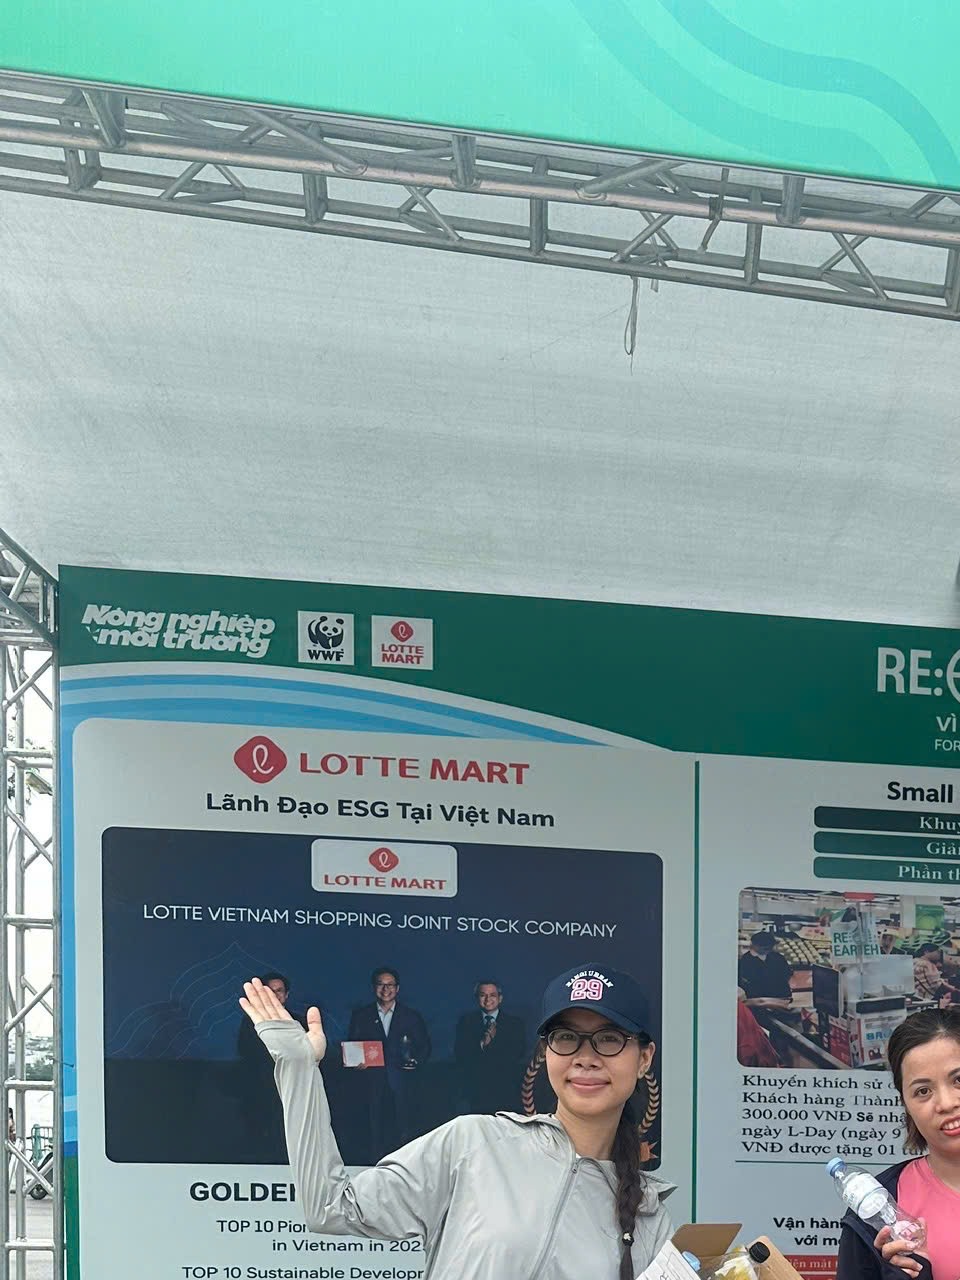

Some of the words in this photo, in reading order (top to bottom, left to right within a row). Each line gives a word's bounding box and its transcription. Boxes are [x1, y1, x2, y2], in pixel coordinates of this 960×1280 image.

[308, 649, 344, 661] WWF
[381, 643, 423, 654] LOTTE
[382, 653, 423, 664] MART
[876, 646, 943, 696] RE:
[936, 714, 958, 733] VÌ
[300, 753, 419, 778] LOTTE
[430, 759, 529, 785] MART
[887, 780, 953, 804] Small
[206, 793, 268, 813] Lãnh
[277, 797, 328, 819] Đạo
[338, 798, 388, 819] ESG
[396, 800, 432, 821] Tại
[440, 802, 489, 827] Việt
[497, 808, 554, 827] Nam
[898, 865, 942, 881] Phần
[324, 875, 386, 888] LOTTE
[391, 877, 446, 890] MART
[143, 905, 202, 921] LOTTE
[208, 907, 289, 924] VIETNAM
[295, 910, 392, 928] SHOPPING
[397, 914, 450, 931] JOINT
[457, 917, 519, 934] STOCK
[524, 920, 616, 939] COMPANY
[570, 979, 603, 1001] 29
[742, 1075, 807, 1089] Khuyến
[813, 1077, 858, 1089] khích
[742, 1092, 797, 1104] Khách
[804, 1093, 845, 1108] hàng
[742, 1109, 808, 1120] 300.000
[813, 1111, 852, 1121] VNĐ
[742, 1126, 782, 1138] ngày
[788, 1127, 836, 1140] L-Day
[842, 1127, 887, 1141] (ngày
[742, 1142, 783, 1152] VNĐ
[789, 1142, 830, 1155] được
[837, 1144, 872, 1157] tặng
[878, 1145, 895, 1155] 01
[217, 1220, 250, 1232] TOP
[254, 1220, 273, 1232] 10
[773, 1218, 804, 1230] Vận
[272, 1240, 286, 1251] in
[292, 1240, 362, 1251] Vietnam
[369, 1240, 383, 1251] in
[795, 1235, 817, 1245] với
[182, 1267, 218, 1278] TOP
[224, 1267, 241, 1278] 10
[247, 1267, 344, 1278] Sustainable
